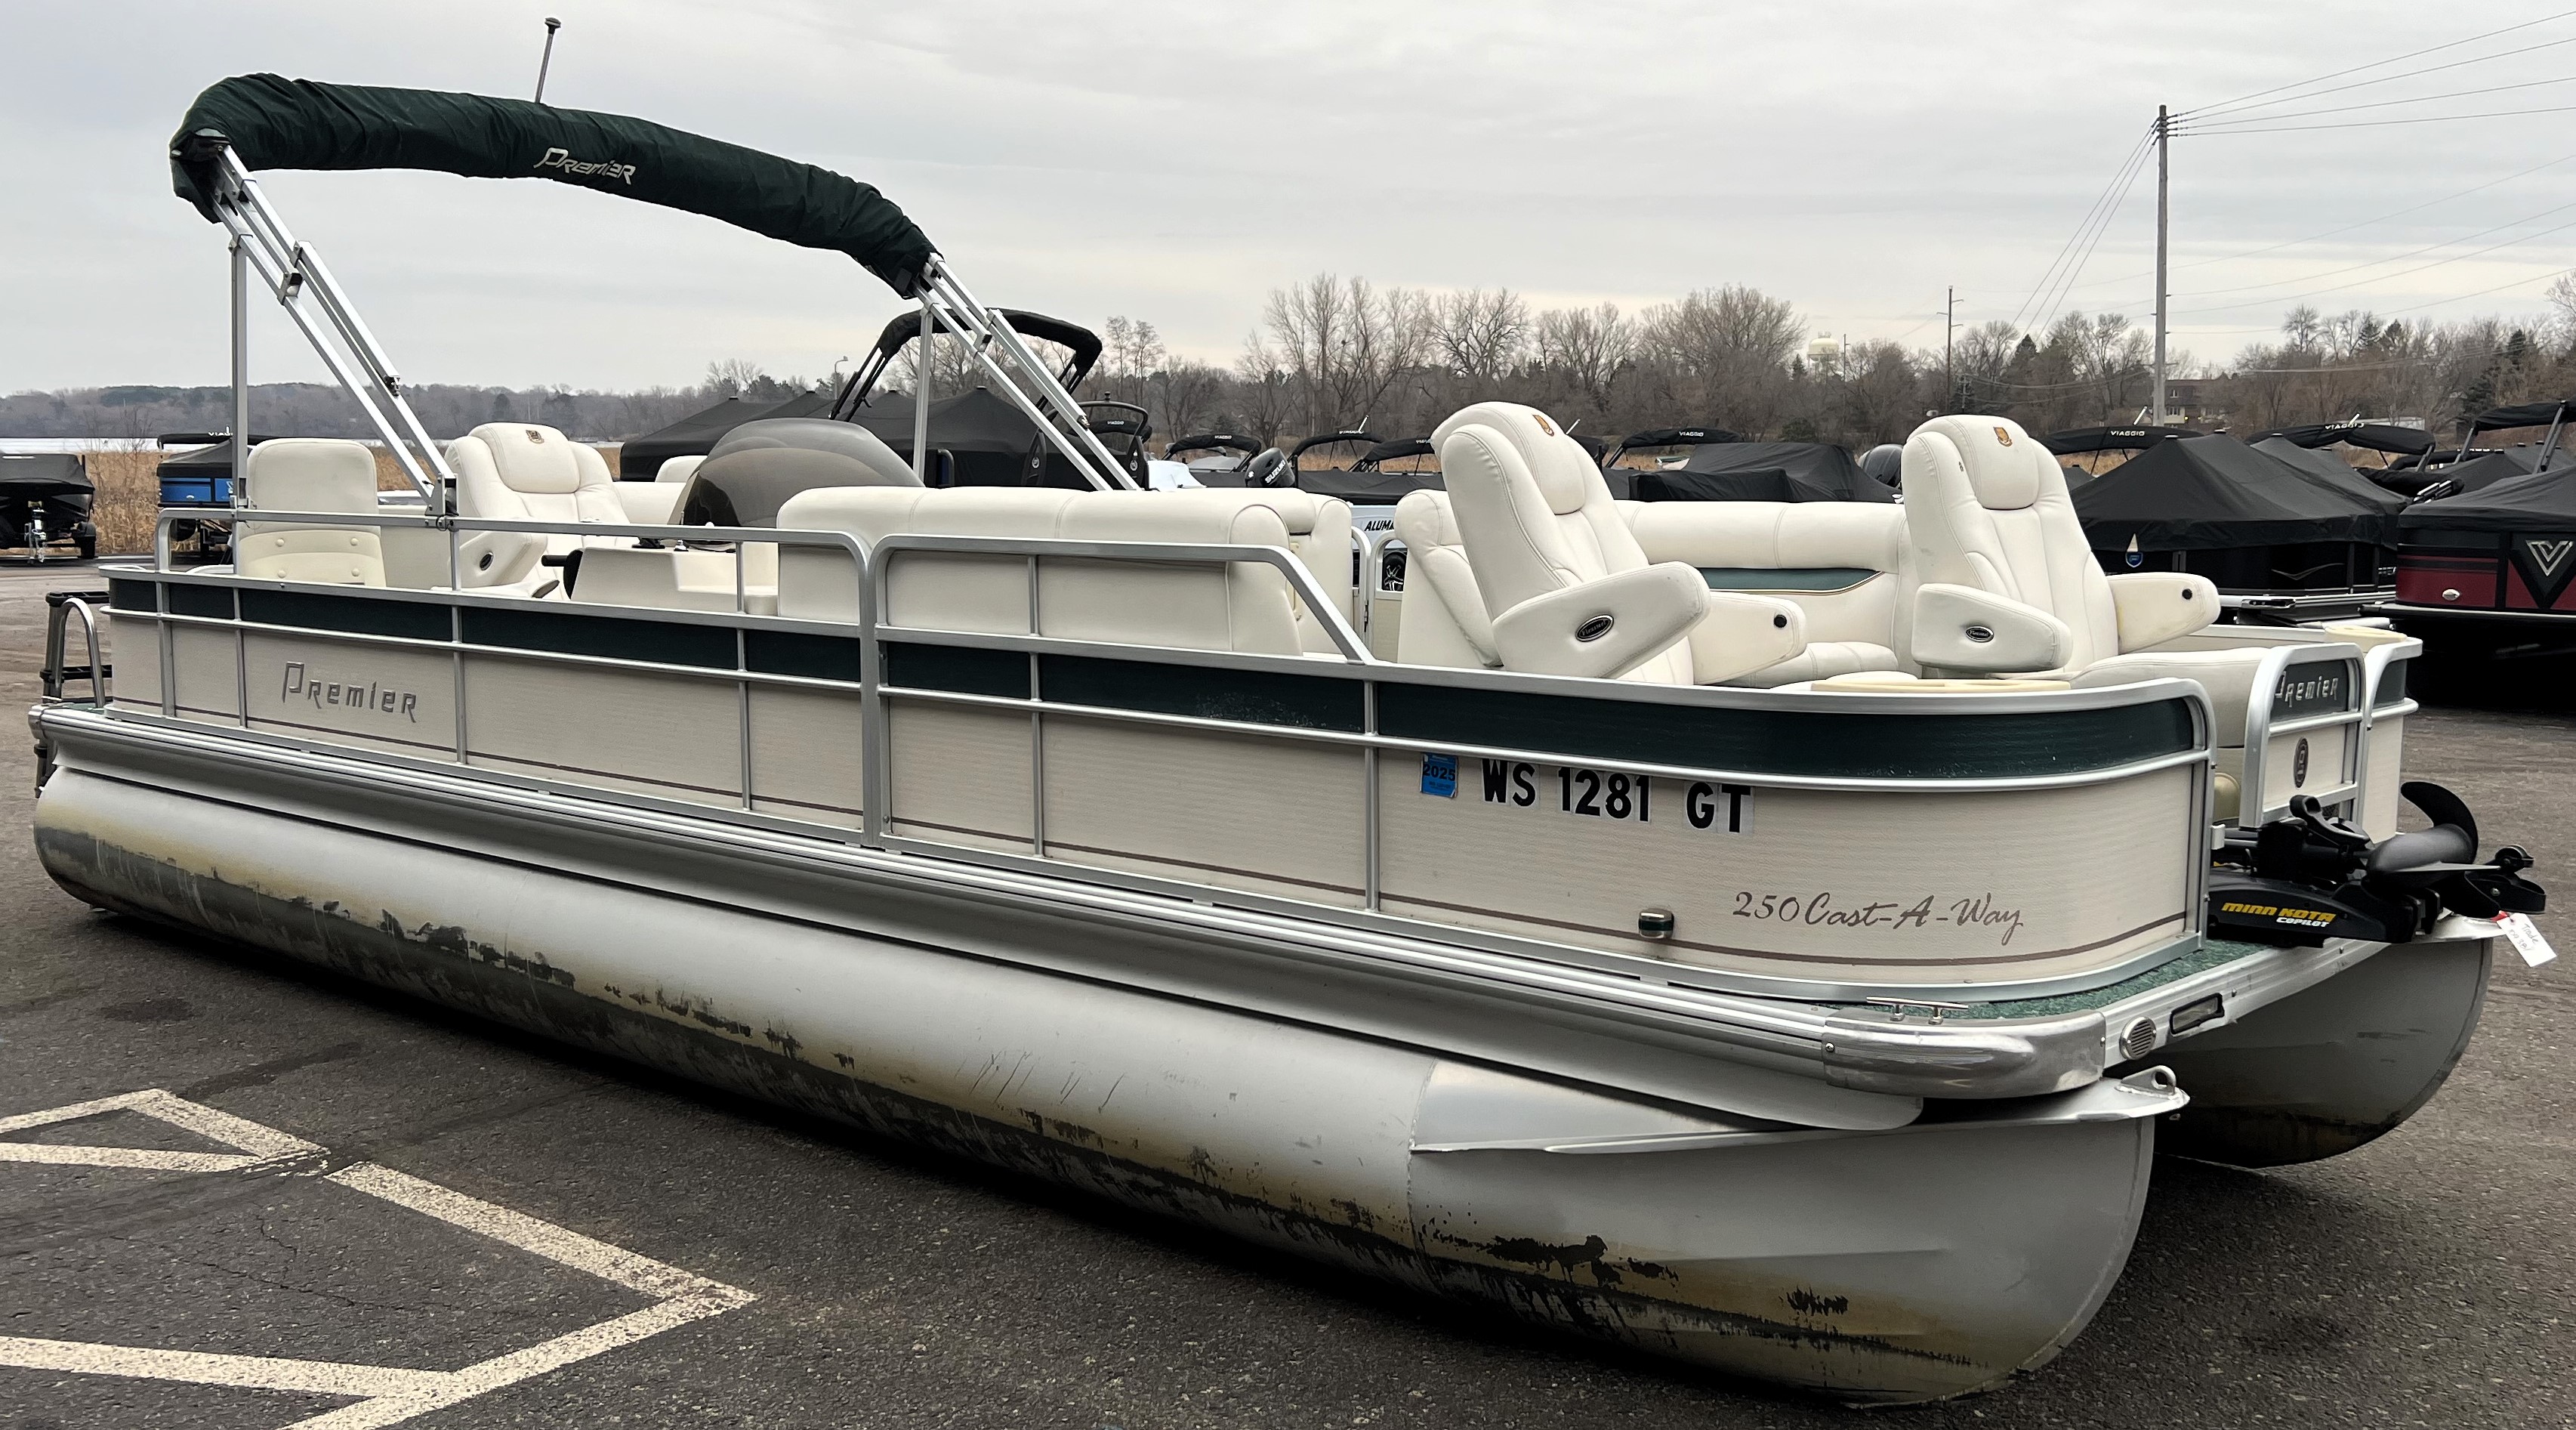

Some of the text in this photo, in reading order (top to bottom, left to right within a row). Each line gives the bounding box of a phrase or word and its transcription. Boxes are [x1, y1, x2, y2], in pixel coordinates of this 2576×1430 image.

[1423, 763, 1456, 781] 2025
[1482, 758, 1751, 833] WS 1281 GT
[2276, 916, 2330, 928] COPILOT
[2278, 908, 2337, 923] KOTA
